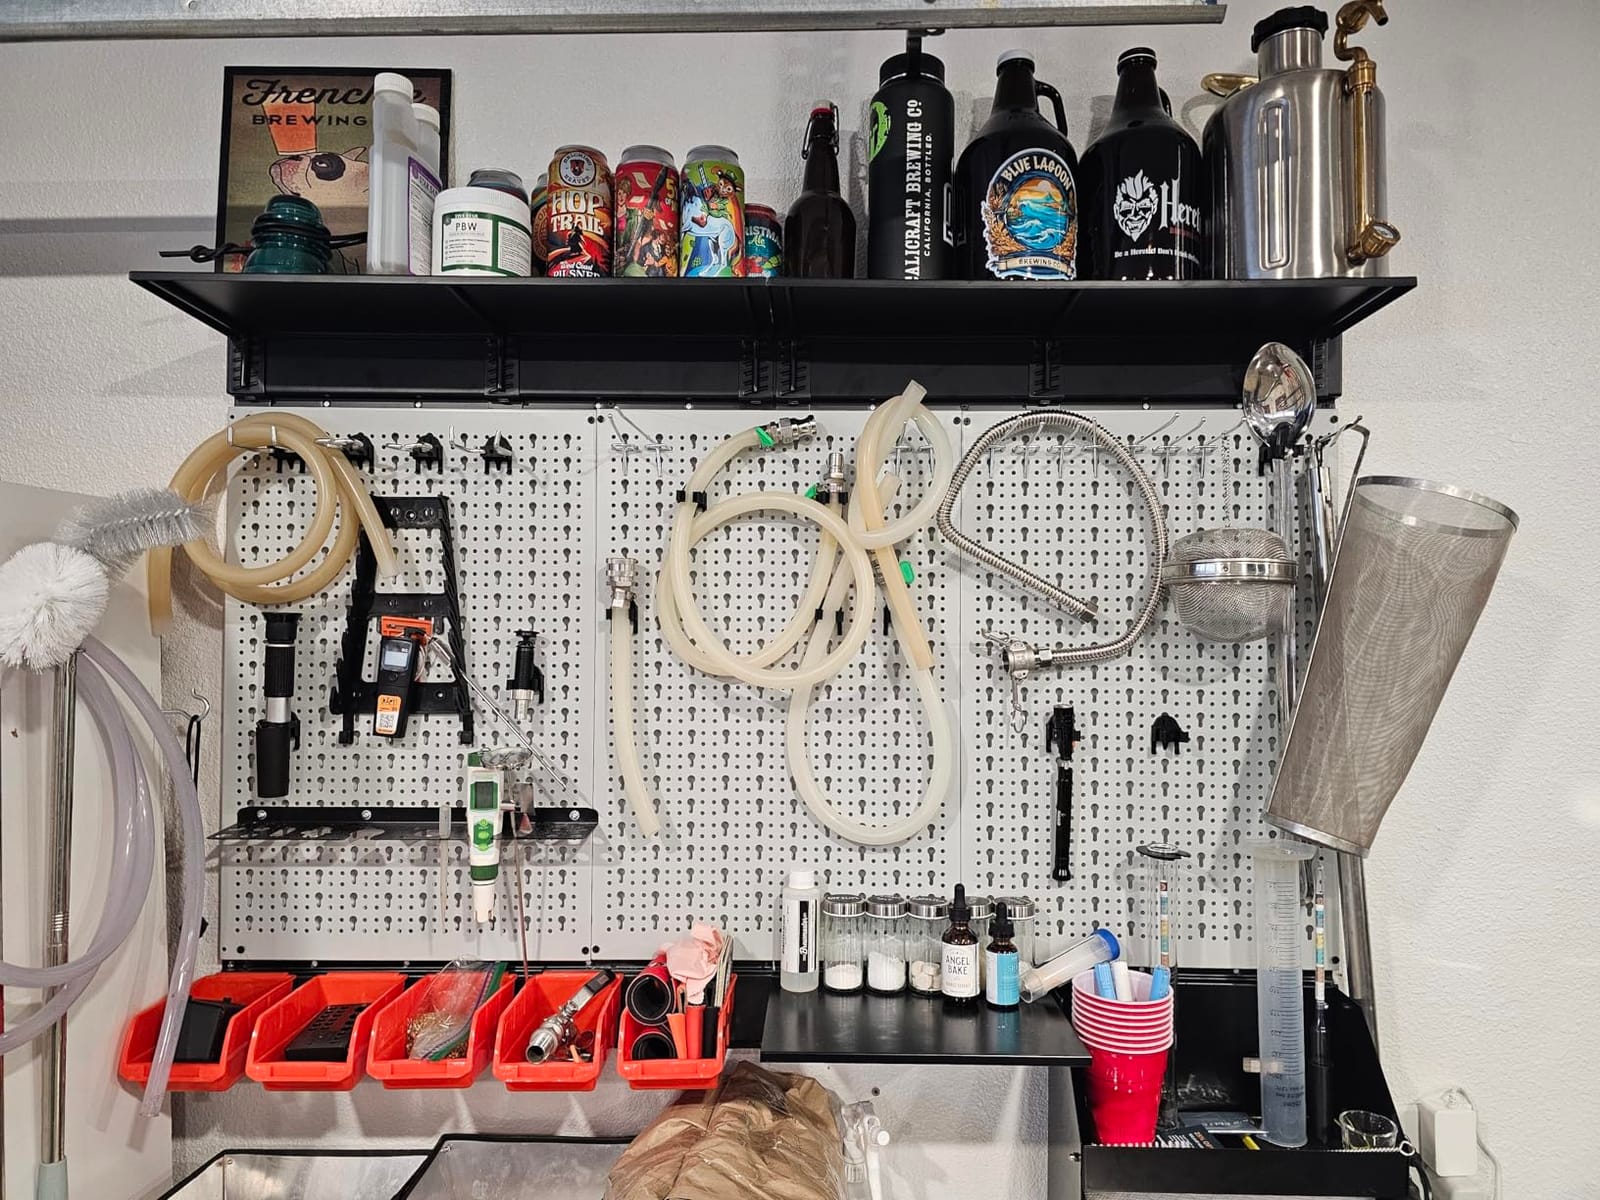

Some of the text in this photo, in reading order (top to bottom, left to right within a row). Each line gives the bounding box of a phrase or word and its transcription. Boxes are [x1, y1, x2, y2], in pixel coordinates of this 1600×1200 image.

[242, 79, 426, 106] Frence
[252, 114, 367, 126] BREWING
[906, 122, 922, 193] BREWING
[1000, 155, 1072, 191] BLUE LAGOON
[552, 191, 604, 215] HOP
[455, 223, 478, 231] PBW
[551, 213, 604, 236] TRAIL
[924, 188, 932, 257] CALIFORNIA.
[945, 955, 970, 965] ANGEL
[948, 966, 968, 975] BAKE
